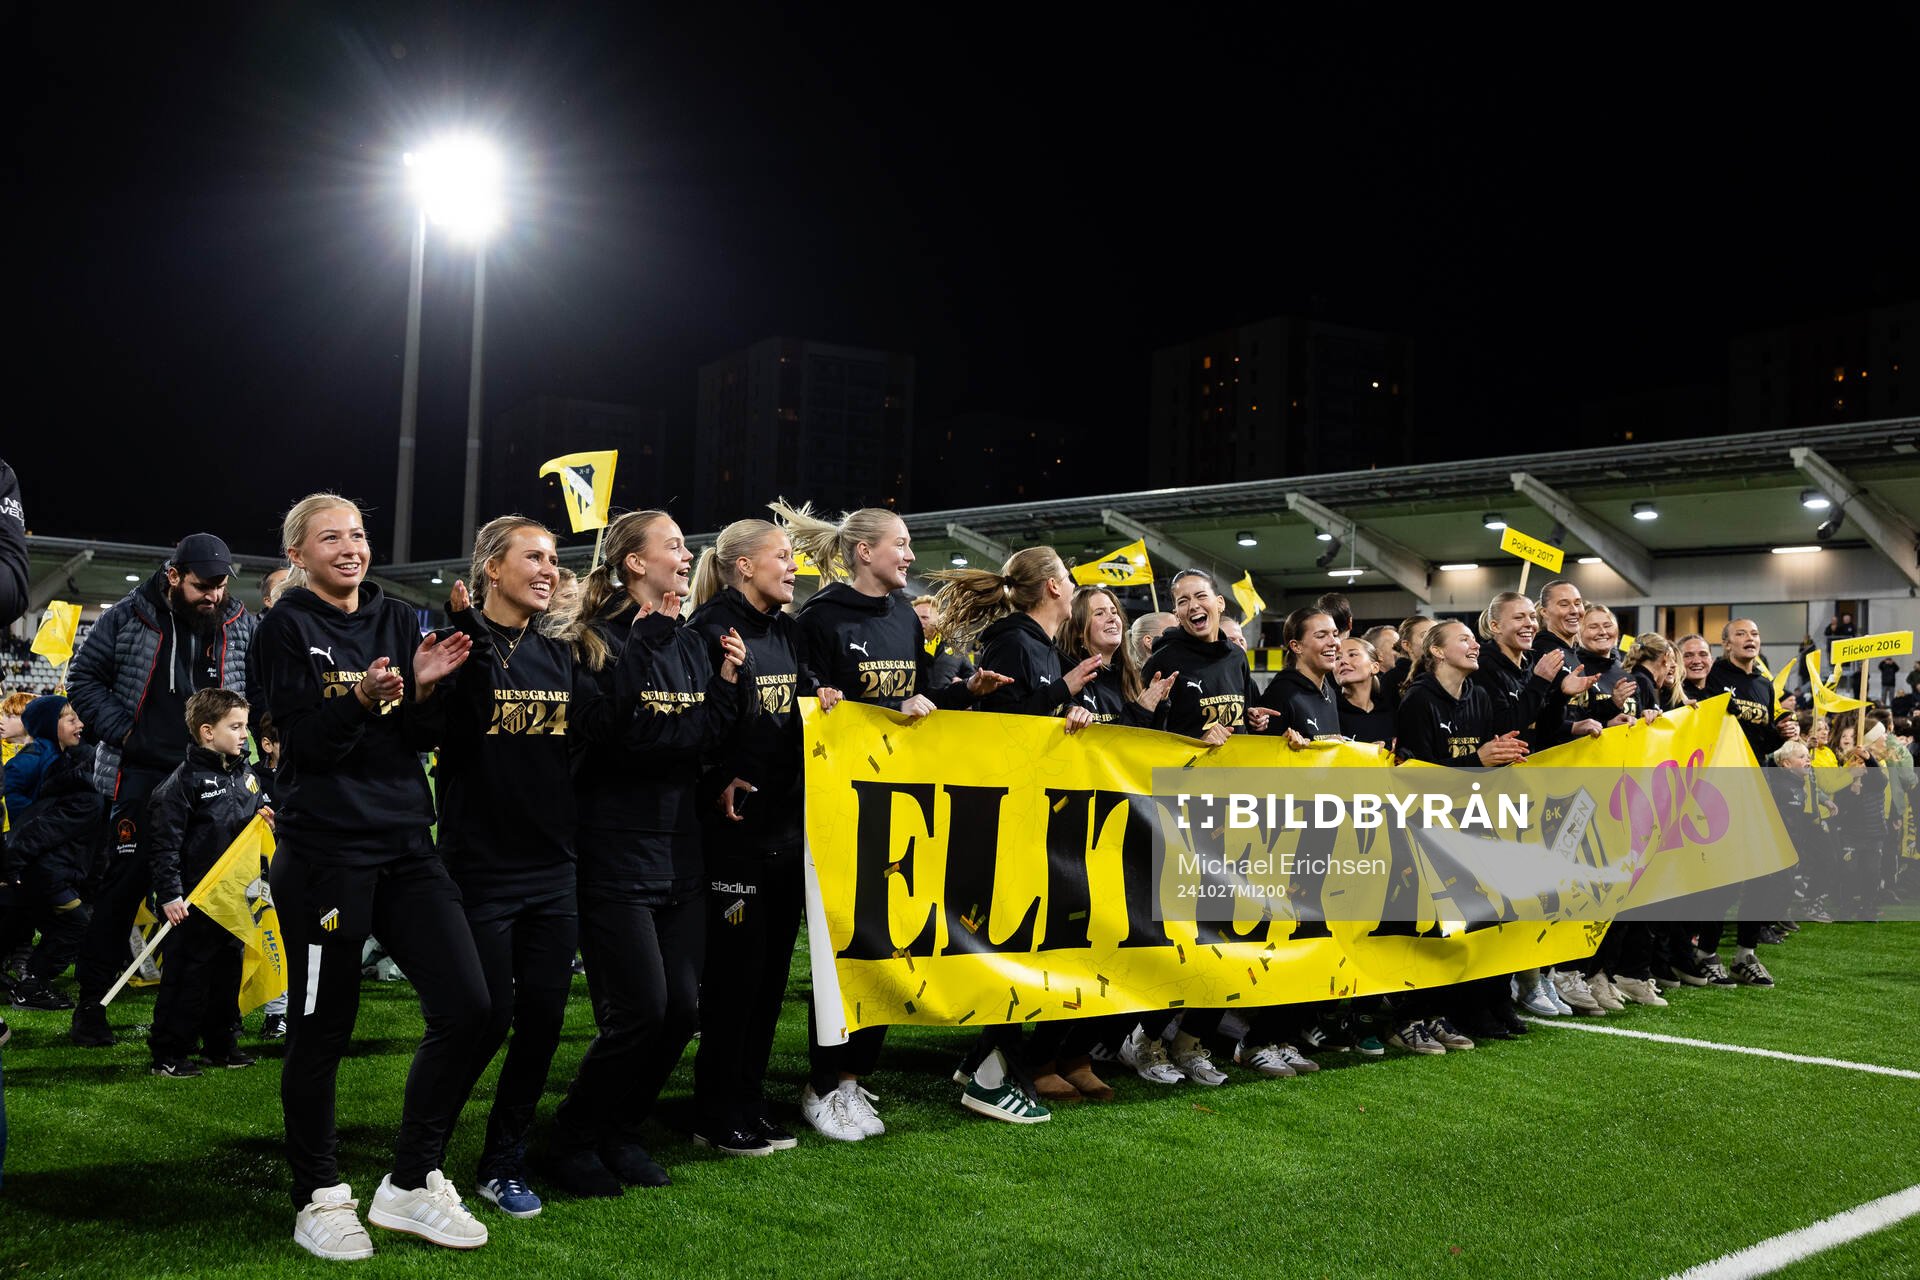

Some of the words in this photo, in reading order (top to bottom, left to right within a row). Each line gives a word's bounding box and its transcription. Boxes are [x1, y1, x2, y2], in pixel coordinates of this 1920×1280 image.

[1511, 538, 1535, 555] Pojkar
[1536, 548, 1554, 563] 2017
[1842, 643, 1875, 657] Flickor
[1876, 639, 1901, 651] 2016
[711, 881, 757, 894] stadium
